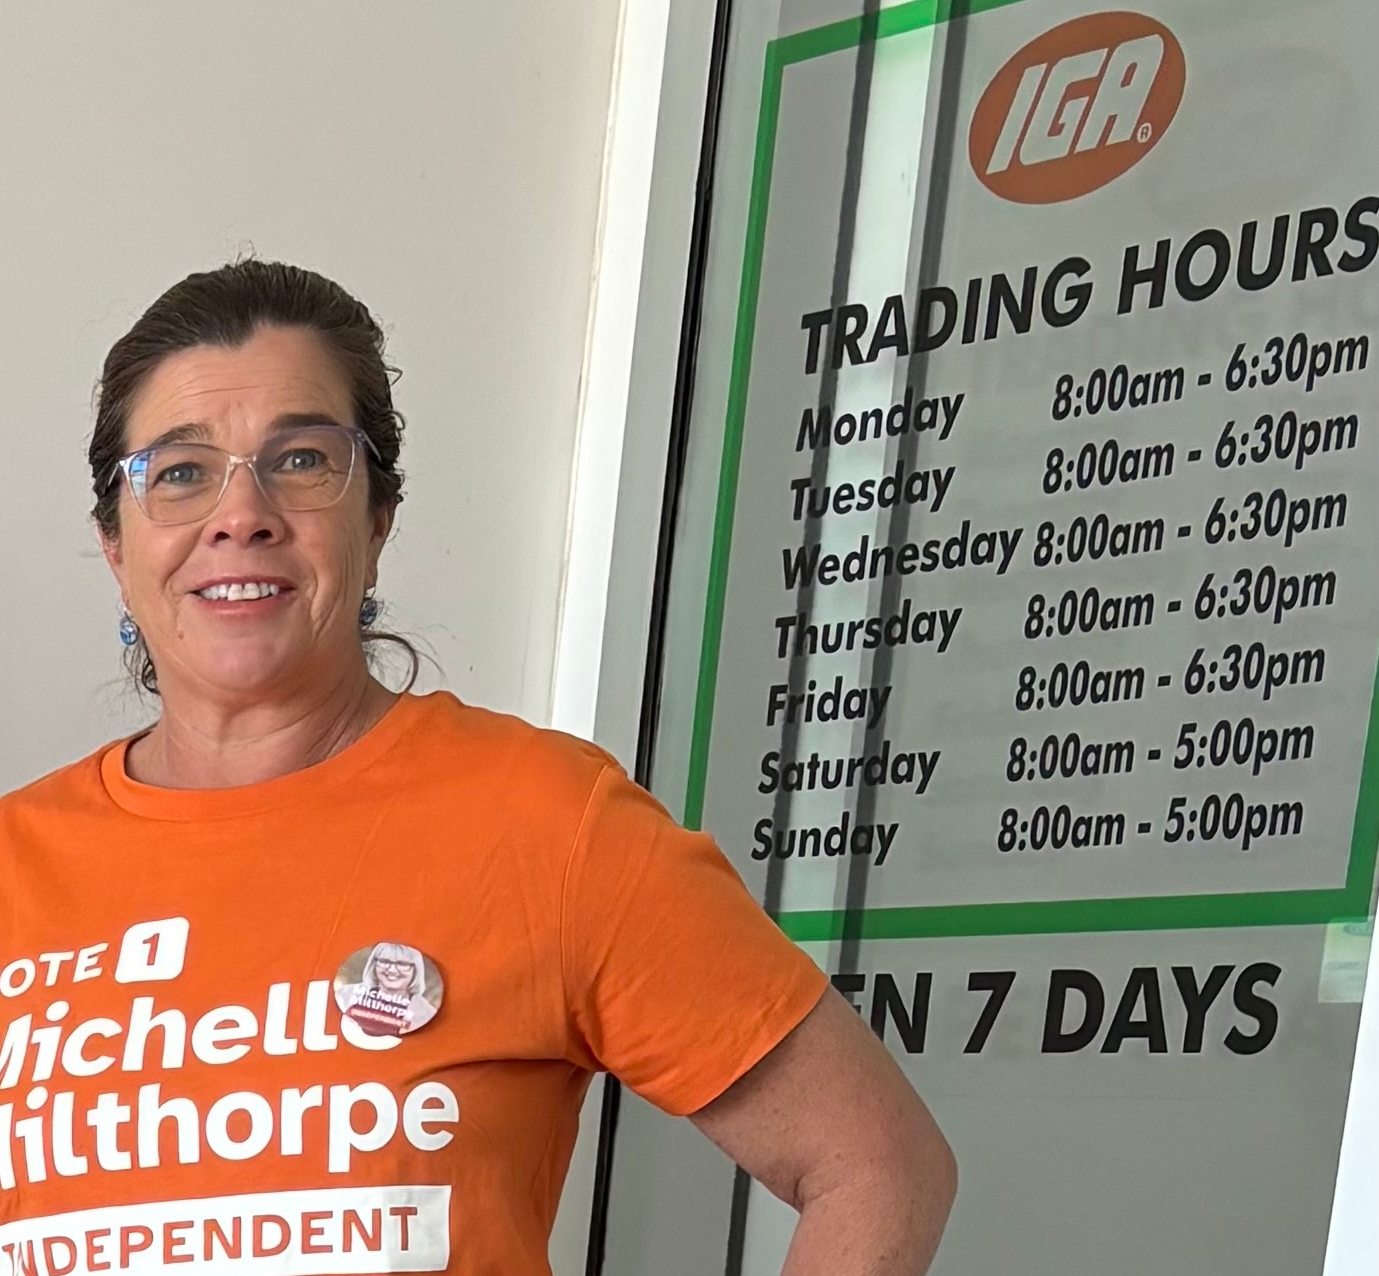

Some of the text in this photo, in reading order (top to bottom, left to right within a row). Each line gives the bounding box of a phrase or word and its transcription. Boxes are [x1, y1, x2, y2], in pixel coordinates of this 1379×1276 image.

[801, 197, 1379, 374] TRADING HOURS
[796, 386, 964, 453] Monday
[1052, 364, 1184, 421] 8:00am
[1226, 334, 1368, 394] 6:30pm
[790, 461, 955, 521] Tuesday
[1043, 439, 1173, 495] 8:00am
[1215, 412, 1358, 470] 6:30pm
[782, 520, 1023, 590] Wednesday
[1033, 513, 1163, 567] 8:00am
[1205, 490, 1347, 547] 6:30pm
[776, 599, 962, 659] Thursday
[1024, 586, 1154, 640] 8:00am
[1195, 565, 1337, 623] 6:30pm
[766, 676, 891, 730] Friday
[1015, 661, 1144, 711] 8:00am
[1184, 642, 1325, 700] 6:30pm
[758, 740, 940, 794] Saturday
[1006, 733, 1134, 783] 8:00am
[1173, 718, 1314, 776] 5:00pm
[750, 811, 899, 865] Sunday
[997, 805, 1125, 853] 8:00am
[1164, 793, 1303, 850] 5:00pm
[141, 933, 160, 966] 1
[963, 970, 1017, 1055] 7
[1040, 962, 1282, 1055] DAYS
